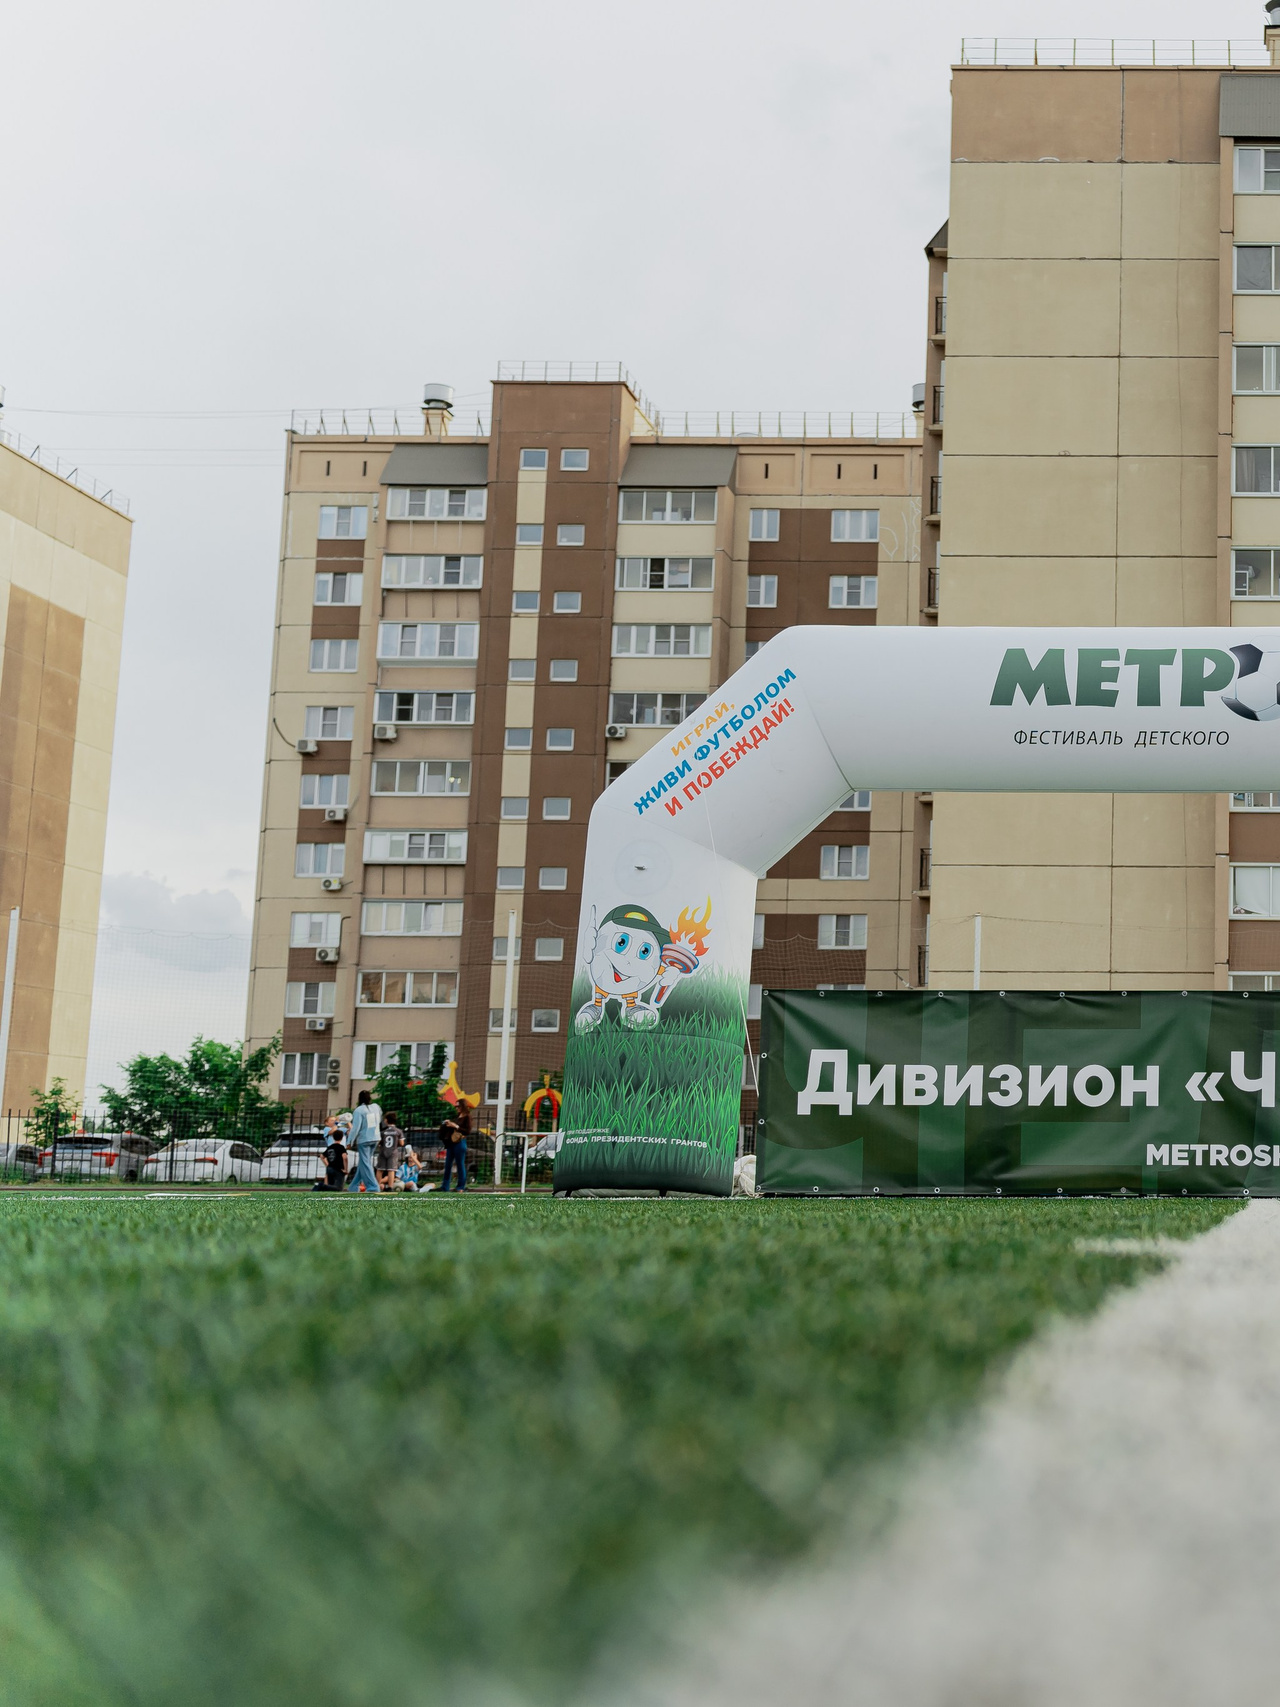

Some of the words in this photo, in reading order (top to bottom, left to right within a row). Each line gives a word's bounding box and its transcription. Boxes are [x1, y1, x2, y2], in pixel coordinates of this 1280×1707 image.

[633, 759, 693, 815] ЖИВИ
[693, 668, 797, 761] ФУТБОЛОМ
[671, 701, 735, 757] ИГРАЙ,
[1014, 729, 1124, 746] ФЕСТИВАЛЬ
[1134, 730, 1230, 748] ДЕТСКОГО
[664, 796, 684, 817] И
[682, 698, 795, 802] ПОБЕЖДАЙ!
[797, 1048, 1160, 1116] Дивизион
[385, 1135, 394, 1148] 9
[566, 1136, 588, 1145] ФОНДА
[591, 1135, 667, 1145] ПРЕЗИДЕНТСКИХ
[670, 1138, 708, 1149] ГРАНТОВ
